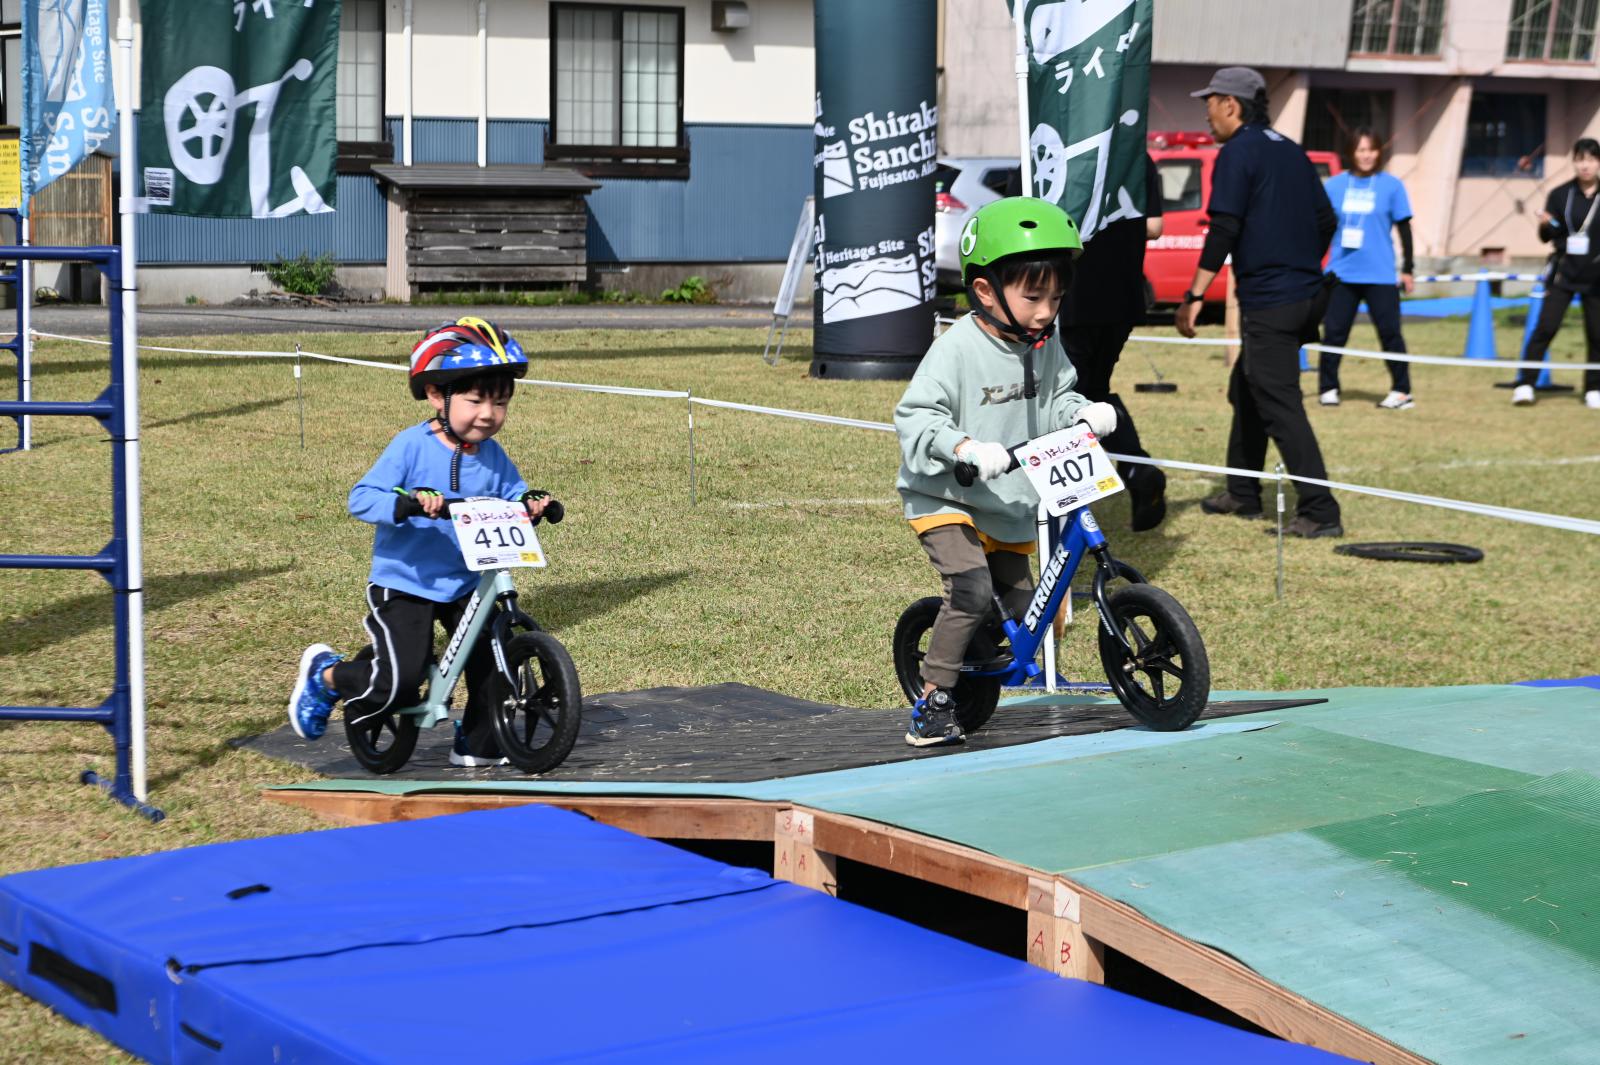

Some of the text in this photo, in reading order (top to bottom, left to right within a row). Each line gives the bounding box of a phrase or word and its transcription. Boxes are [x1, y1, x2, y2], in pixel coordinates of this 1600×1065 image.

[86, 0, 105, 84] itage Site
[853, 131, 936, 174] Sanchi
[859, 169, 919, 190] Fujisato,
[826, 245, 876, 264] Heritage
[878, 240, 905, 254] Site
[1050, 452, 1094, 487] 407
[474, 526, 525, 548] 410
[1024, 543, 1070, 632] STRIDER
[440, 590, 481, 677] STRIDER
[780, 850, 806, 872] A A
[1032, 930, 1072, 965] A B
